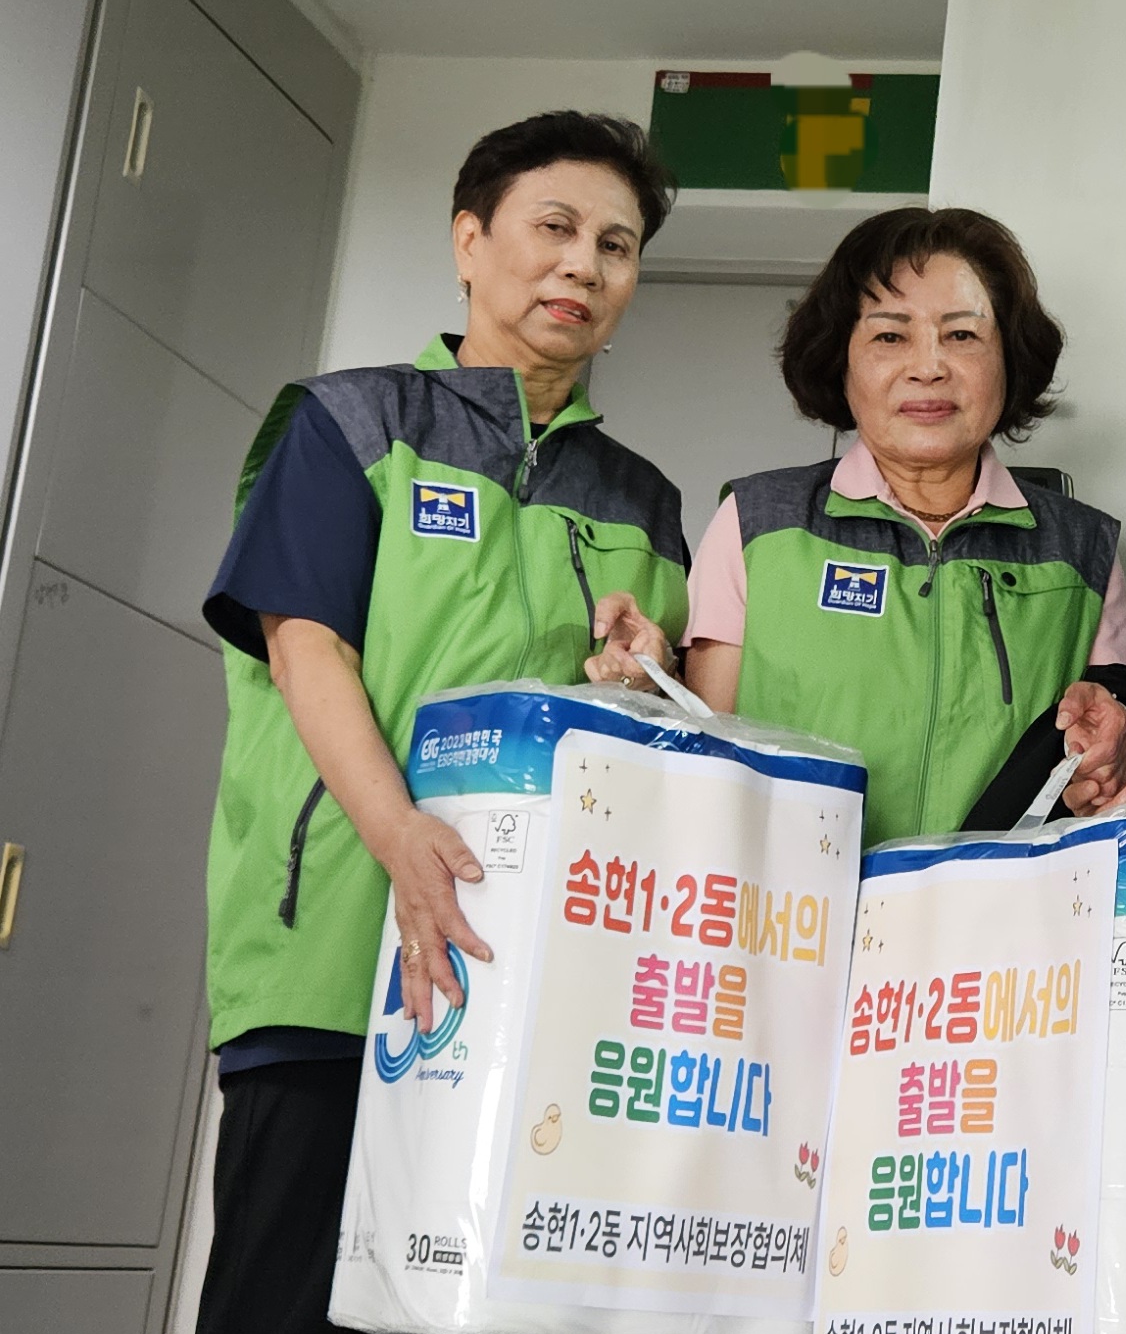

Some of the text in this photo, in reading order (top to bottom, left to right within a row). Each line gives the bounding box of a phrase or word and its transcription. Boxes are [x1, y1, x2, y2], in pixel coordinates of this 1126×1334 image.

[562, 849, 829, 967] 송현1·2동에서의
[630, 953, 748, 1041] 출발을
[849, 959, 1080, 1056] 송현1·2동에서의
[588, 1039, 773, 1136] 응원합니다
[898, 1058, 998, 1137] 출발을
[868, 1147, 1029, 1231] 응원합니다
[406, 1233, 431, 1264] 30
[434, 1236, 468, 1249] ROLLS
[521, 1200, 809, 1274] 송현1·2동 지역사회보장협의체
